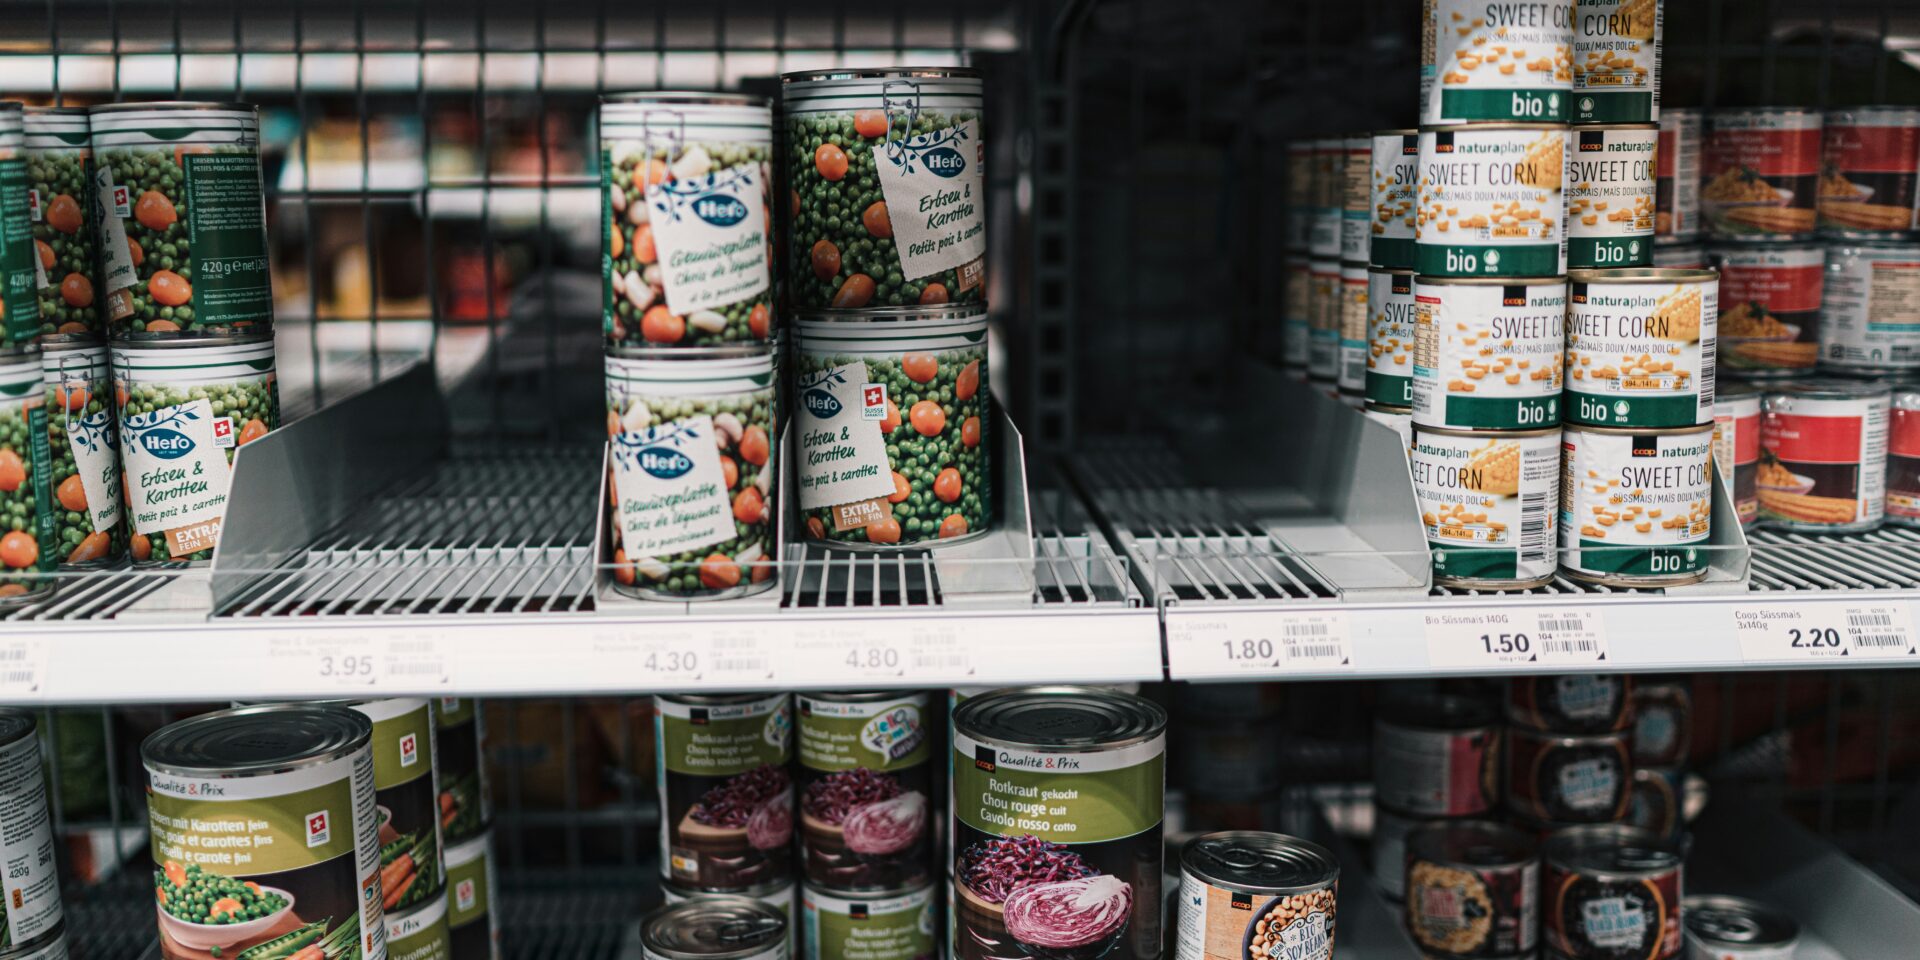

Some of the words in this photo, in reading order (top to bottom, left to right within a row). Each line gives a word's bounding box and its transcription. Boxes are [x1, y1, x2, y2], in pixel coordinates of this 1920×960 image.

[1486, 3, 1547, 28] SWEET
[1584, 14, 1632, 37] CORN
[1575, 41, 1614, 52] OUX/MAIS
[1616, 41, 1636, 51] DOLCE
[1512, 92, 1543, 117] bio
[1458, 140, 1526, 154] naturaplan
[1581, 143, 1603, 151] coop
[929, 153, 963, 169] Hero
[1428, 162, 1481, 186] SWEET
[1488, 162, 1539, 186] CORN
[1570, 161, 1629, 183] SWEET
[698, 199, 745, 217] Hero
[919, 188, 961, 213] Erbsen
[964, 183, 971, 198] &
[926, 203, 975, 230] Karotten
[105, 229, 112, 244] &
[908, 239, 936, 258] Petits
[937, 232, 955, 254] pois
[956, 230, 963, 242] &
[1446, 249, 1477, 273] bio
[1595, 241, 1624, 263] bio
[201, 261, 223, 273] 420
[224, 263, 231, 275] g
[243, 260, 255, 271] net
[1504, 298, 1526, 306] coop
[1591, 295, 1656, 309] naturaplan
[1384, 302, 1415, 324] SWE
[1492, 315, 1549, 340] SWEET
[1567, 311, 1612, 338] SWEET
[1618, 315, 1670, 339] CORN
[808, 394, 839, 411] Hero
[1517, 400, 1545, 425] bio
[1580, 397, 1608, 422] bio
[146, 435, 190, 450] Hero
[803, 429, 836, 449] Erbsen
[840, 425, 850, 441] &
[641, 452, 690, 471] Hero
[807, 445, 857, 467] Karotten
[1418, 443, 1469, 460] naturaplan
[1633, 449, 1656, 457] coop
[141, 467, 187, 488] Erbsen
[193, 460, 204, 475] &
[815, 472, 830, 490] pois
[832, 470, 838, 482] &
[840, 464, 879, 482] carottes
[1414, 461, 1432, 485] EET
[1437, 465, 1483, 491] CORN
[1621, 465, 1683, 489] SWEET
[146, 479, 209, 505] Karotten
[1466, 496, 1489, 506] DOLCE
[138, 510, 158, 523] Petits
[160, 506, 179, 521] pois
[181, 504, 188, 514] &
[192, 494, 227, 511] carotte
[840, 501, 881, 518] EXTRA
[843, 515, 862, 526] FEIN
[868, 511, 884, 522] FIN
[175, 522, 221, 543] EXTRA
[179, 538, 202, 551] FEIN
[1651, 548, 1681, 572] bio
[1425, 615, 1440, 625] Bio
[1442, 614, 1484, 624] Süssmais
[1486, 614, 1509, 624] 140G
[1735, 610, 1758, 620] Coop
[1760, 609, 1802, 619] Süssmais
[1738, 620, 1768, 631] 3x140g
[1480, 633, 1530, 653] 1.50
[1788, 627, 1841, 648] 2.20
[846, 648, 899, 668] 4.80
[1223, 639, 1274, 660] 1.80
[320, 656, 373, 676] 3.95
[644, 651, 697, 671] 4.30
[976, 759, 995, 771] coop
[1000, 751, 1043, 768] Qualité
[1045, 757, 1055, 769] &
[1057, 755, 1080, 769] Prix
[152, 775, 186, 794] Qualité
[188, 783, 199, 795] &
[200, 782, 225, 796] Prix
[989, 778, 1039, 798] Rotkraut
[1041, 789, 1078, 800] gekocht
[982, 792, 1008, 810] Chou
[1011, 801, 1047, 818] rouge
[1049, 806, 1067, 816] cuit
[172, 817, 189, 830] mit
[191, 818, 245, 832] Karotten
[247, 820, 269, 833] fein
[980, 808, 1015, 828] Cavolo
[1017, 818, 1050, 831] rosso
[1053, 822, 1077, 832] cotto
[188, 835, 200, 847] et
[201, 834, 251, 848] carottes
[253, 835, 274, 849] fins
[185, 852, 192, 862] e
[194, 851, 232, 864] carote
[234, 853, 252, 866] fini
[9, 866, 30, 880] 420g
[1232, 901, 1251, 910] coop
[1299, 923, 1316, 942] BIO
[1304, 930, 1326, 955] BEANS
